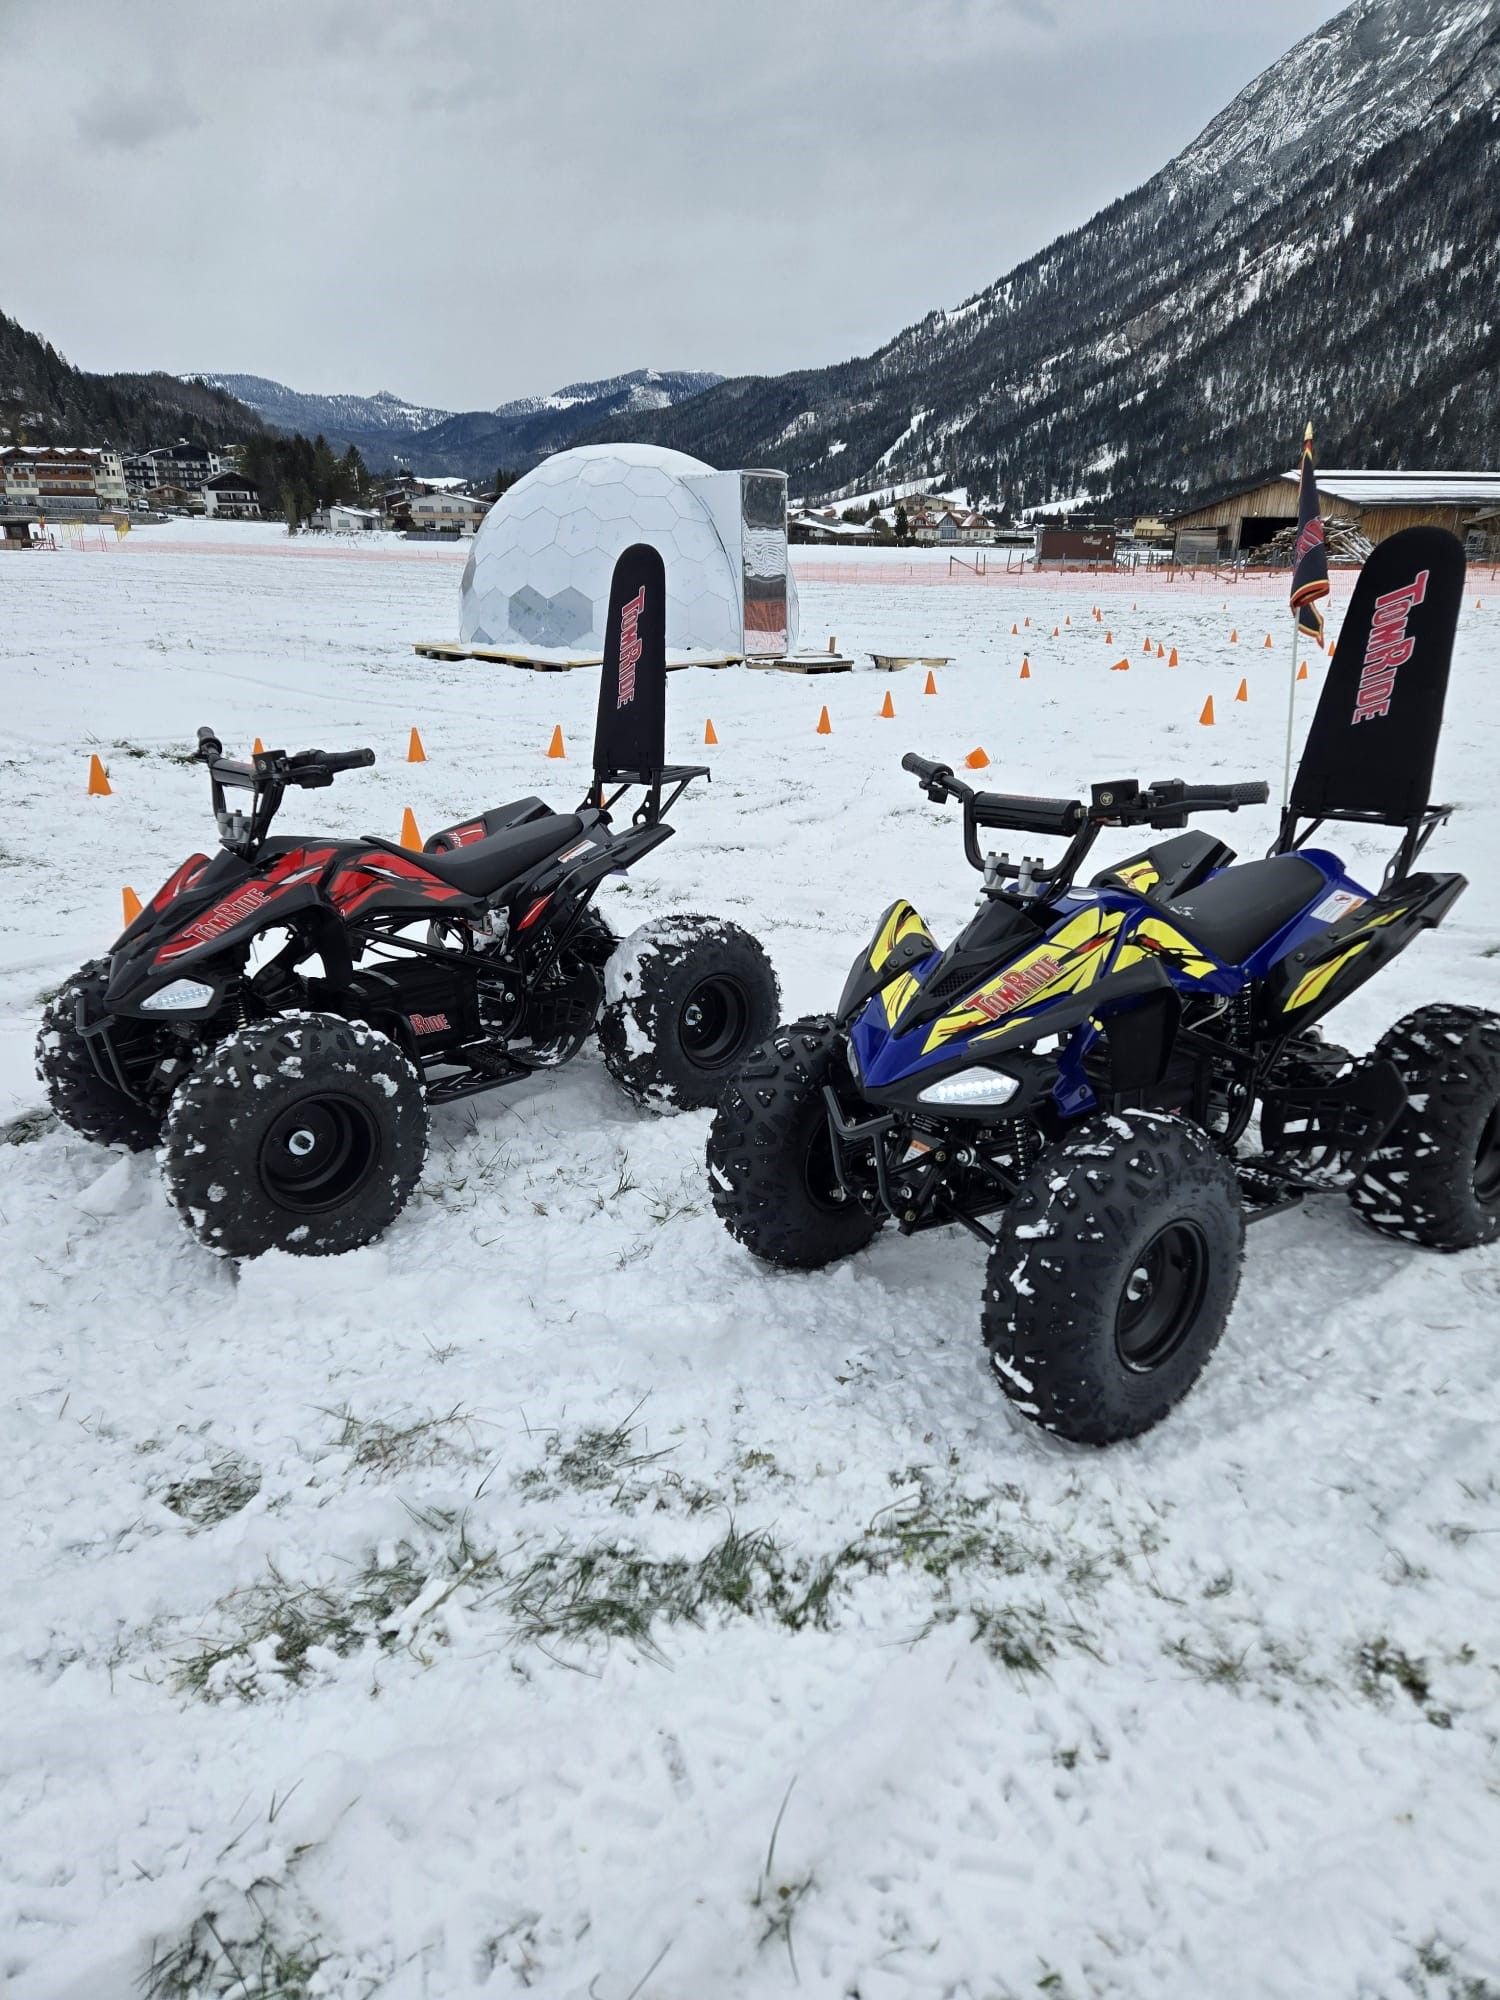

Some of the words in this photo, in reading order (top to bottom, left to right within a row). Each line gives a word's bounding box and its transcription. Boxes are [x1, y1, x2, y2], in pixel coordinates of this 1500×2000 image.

[617, 585, 646, 710] TOMRIDE
[1351, 569, 1430, 725] TOMRIDE
[409, 1013, 452, 1036] RIDE
[962, 953, 1068, 1021] TOMRIDE
